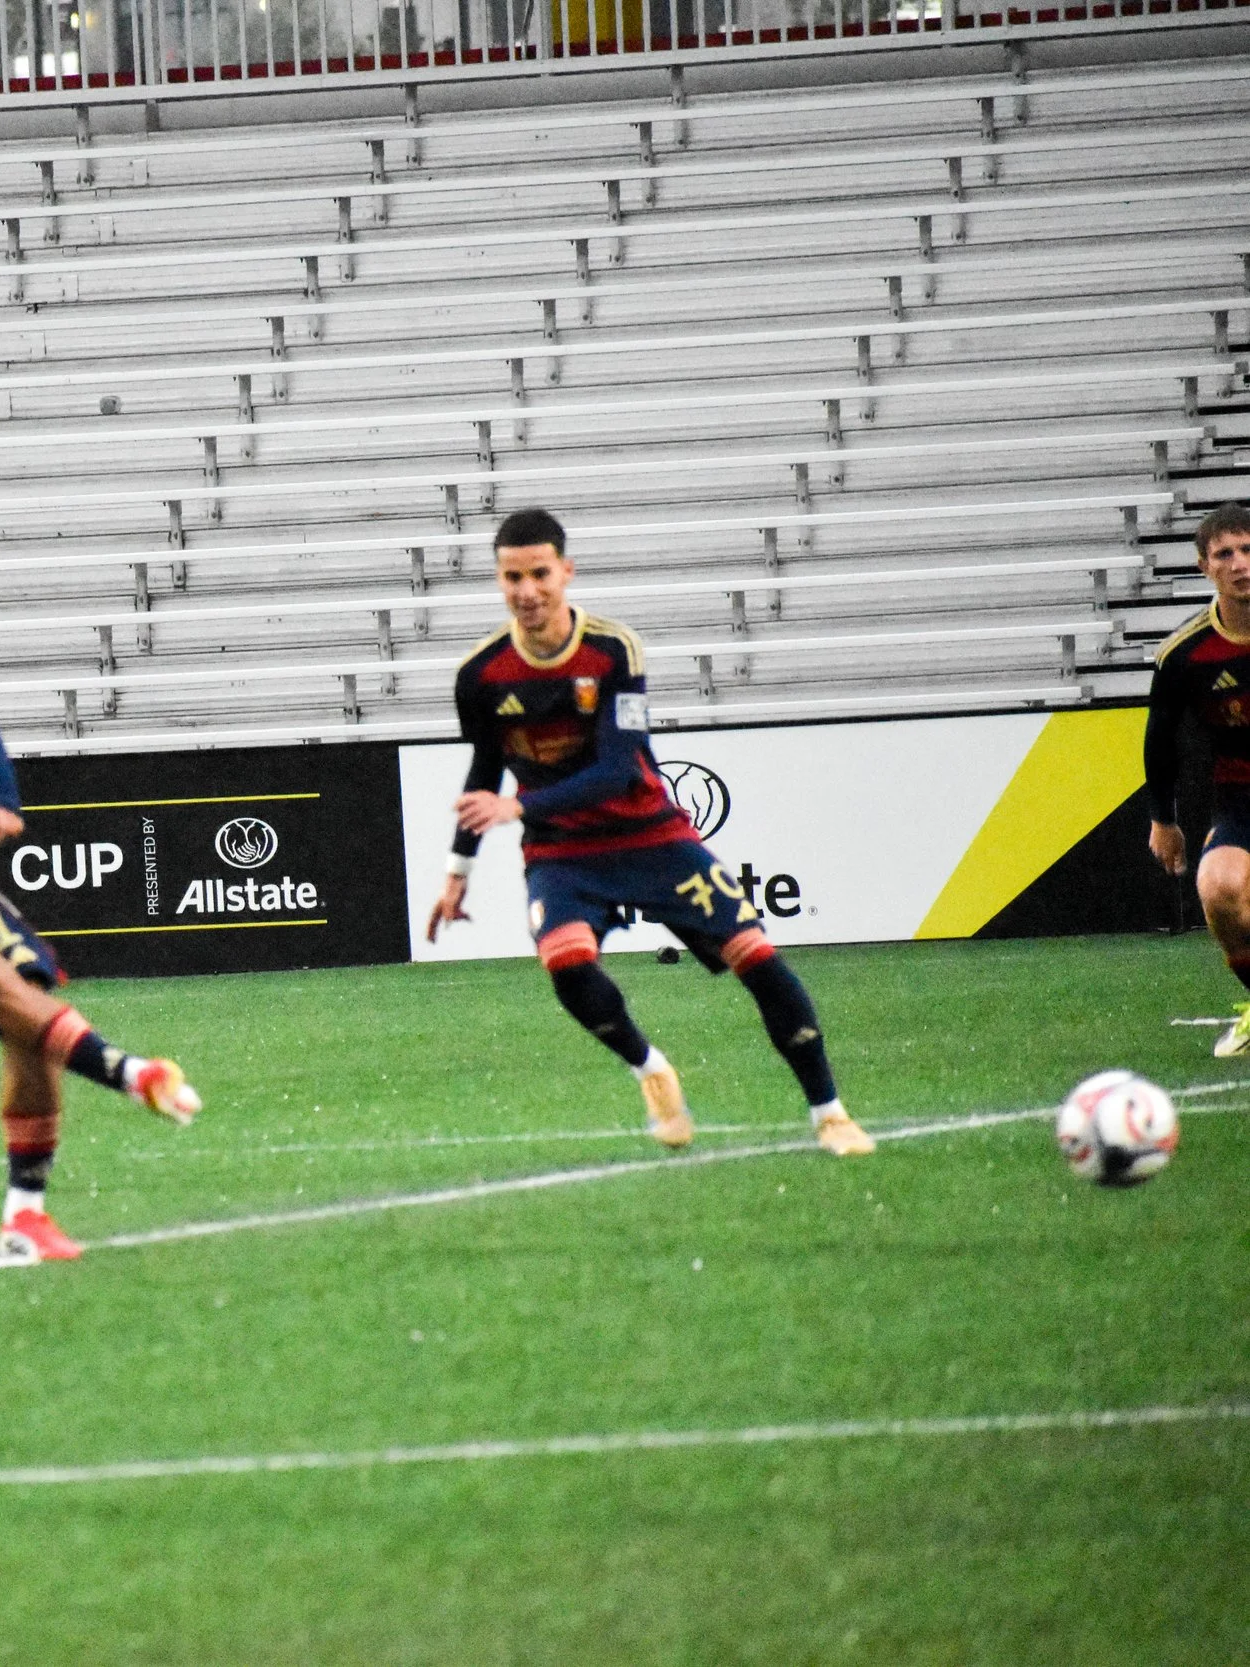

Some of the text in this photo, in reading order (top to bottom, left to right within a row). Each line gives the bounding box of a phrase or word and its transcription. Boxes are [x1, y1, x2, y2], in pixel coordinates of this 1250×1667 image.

[10, 842, 124, 891] CUP
[141, 816, 160, 916] PRESENTED BY
[175, 876, 318, 914] Allstate
